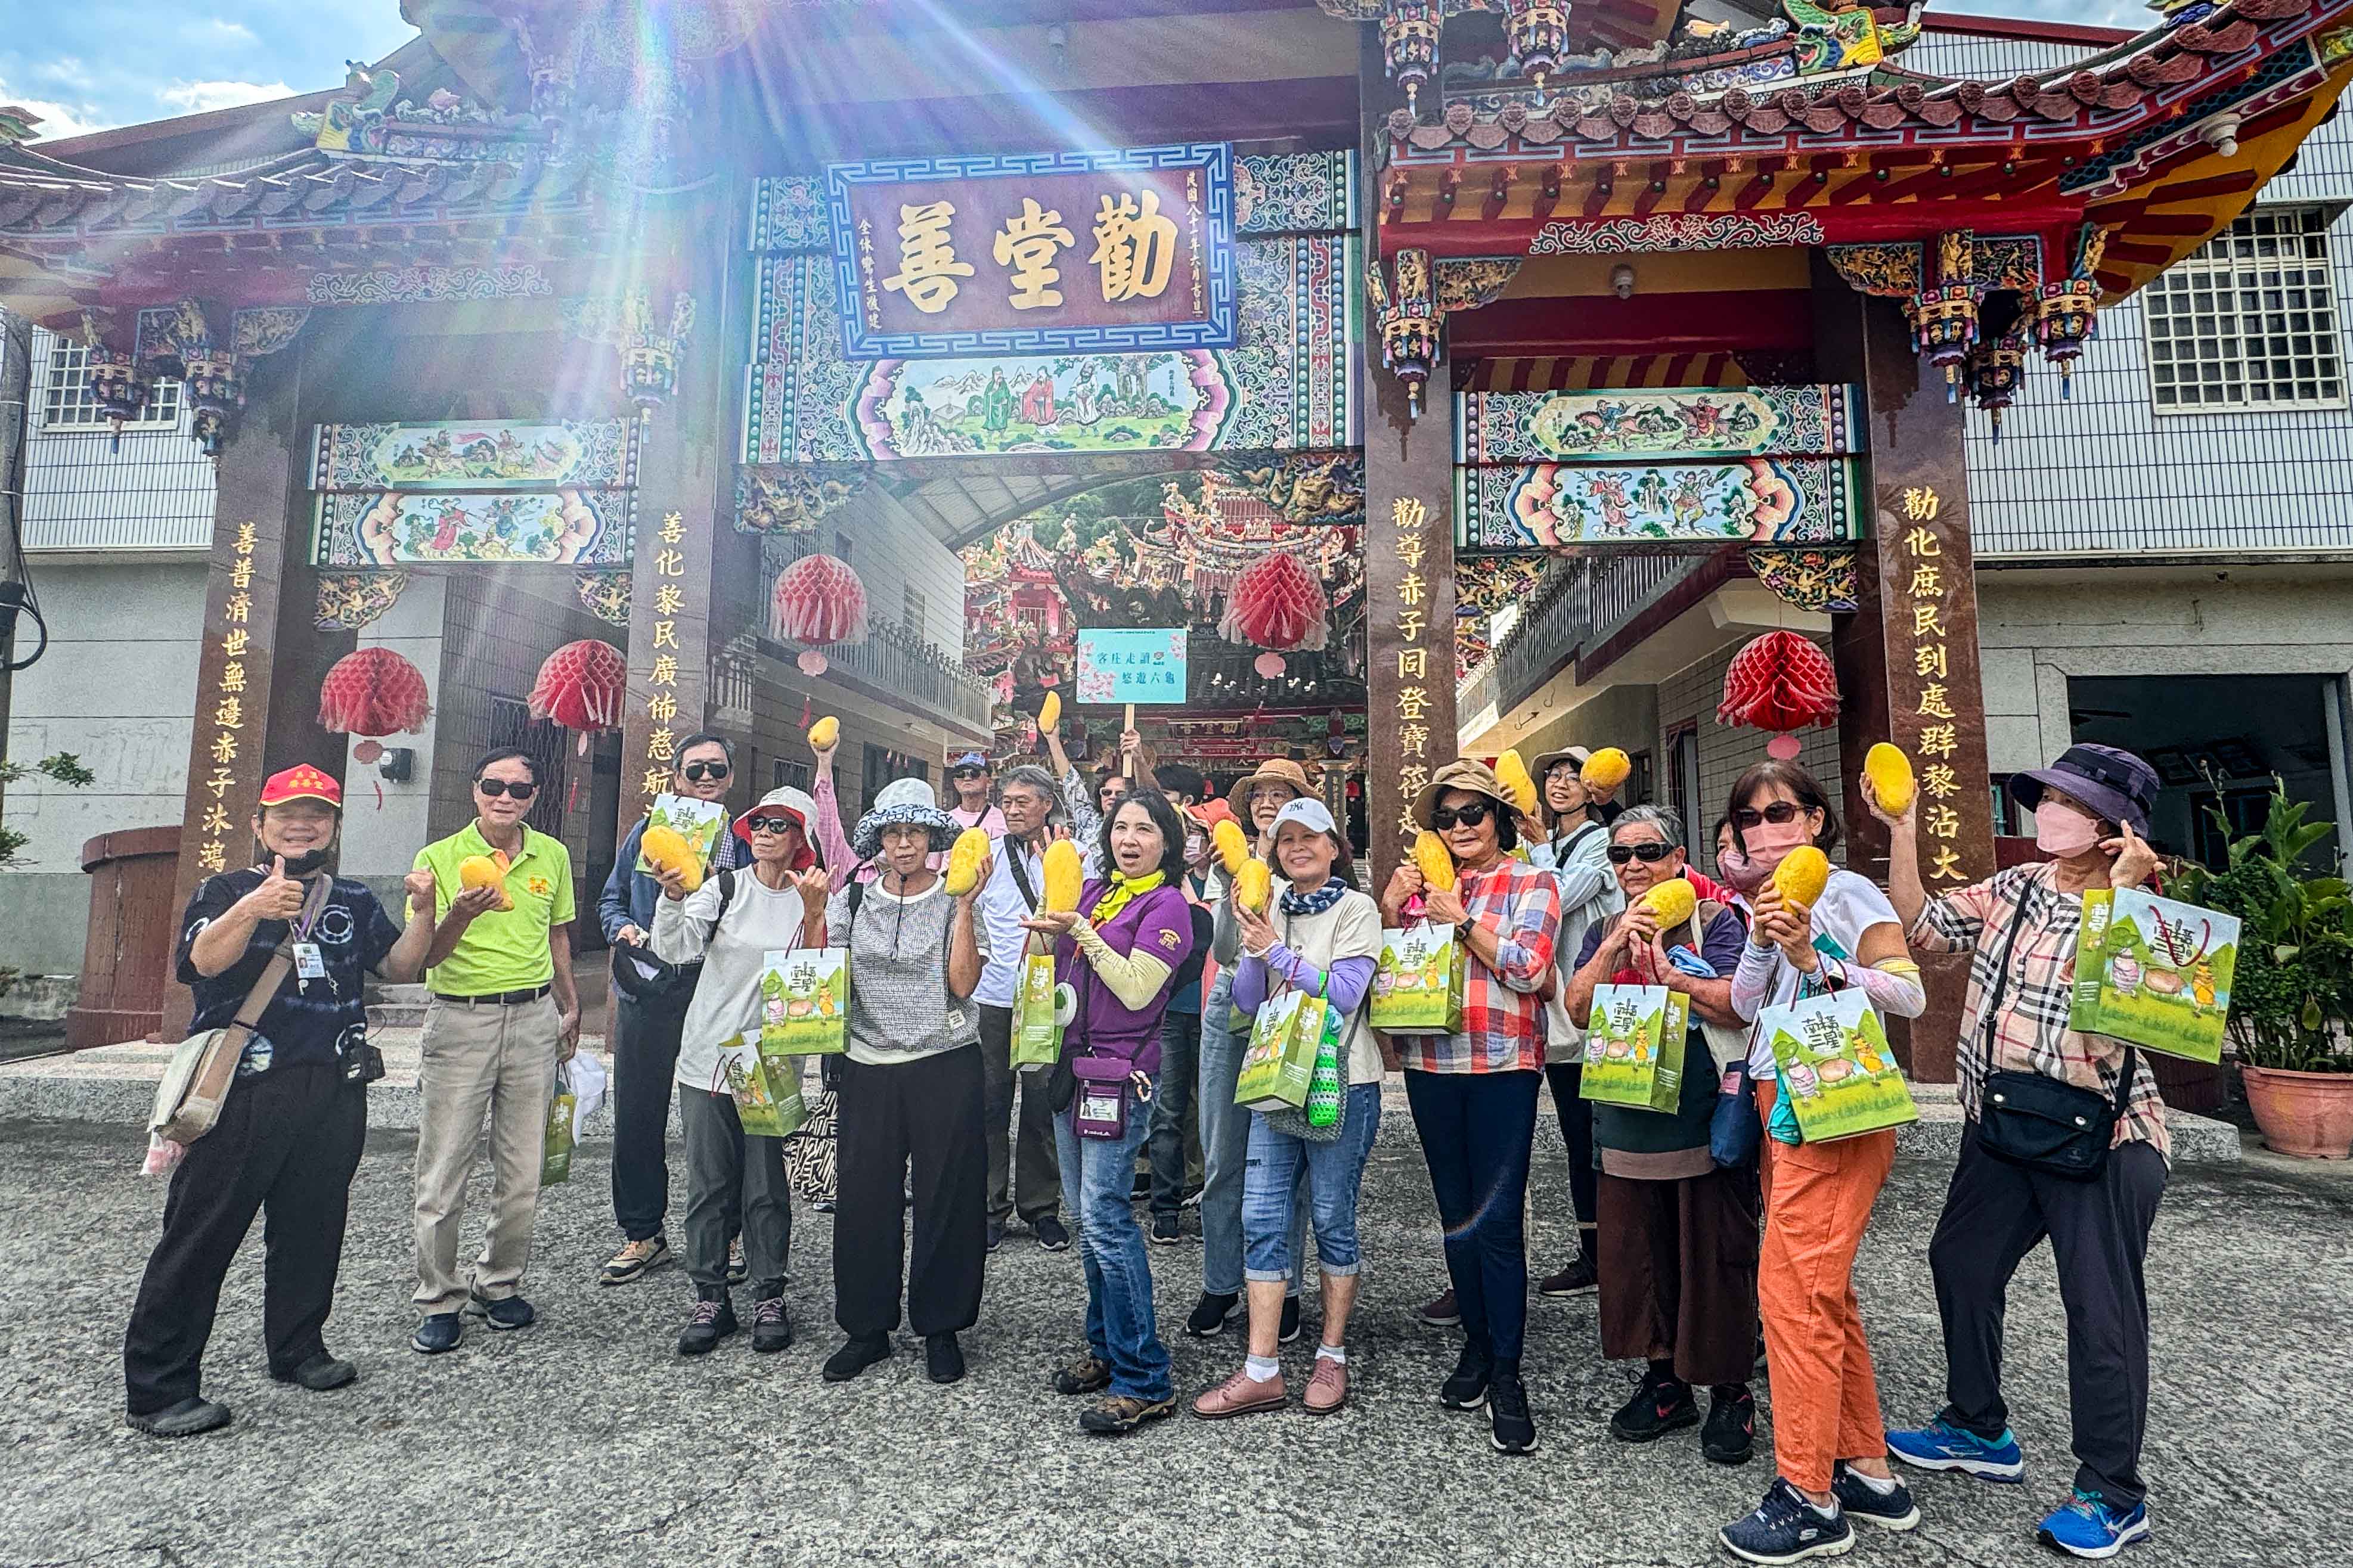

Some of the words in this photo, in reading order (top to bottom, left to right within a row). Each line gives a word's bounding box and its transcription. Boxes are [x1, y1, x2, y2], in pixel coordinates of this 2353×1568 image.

[640, 511, 687, 820] 善化黎民廣佈慈航
[1391, 496, 1433, 868] 勸導赤子同登寶筏
[1902, 486, 1969, 895] 勸化庶民到處群黎沾大
